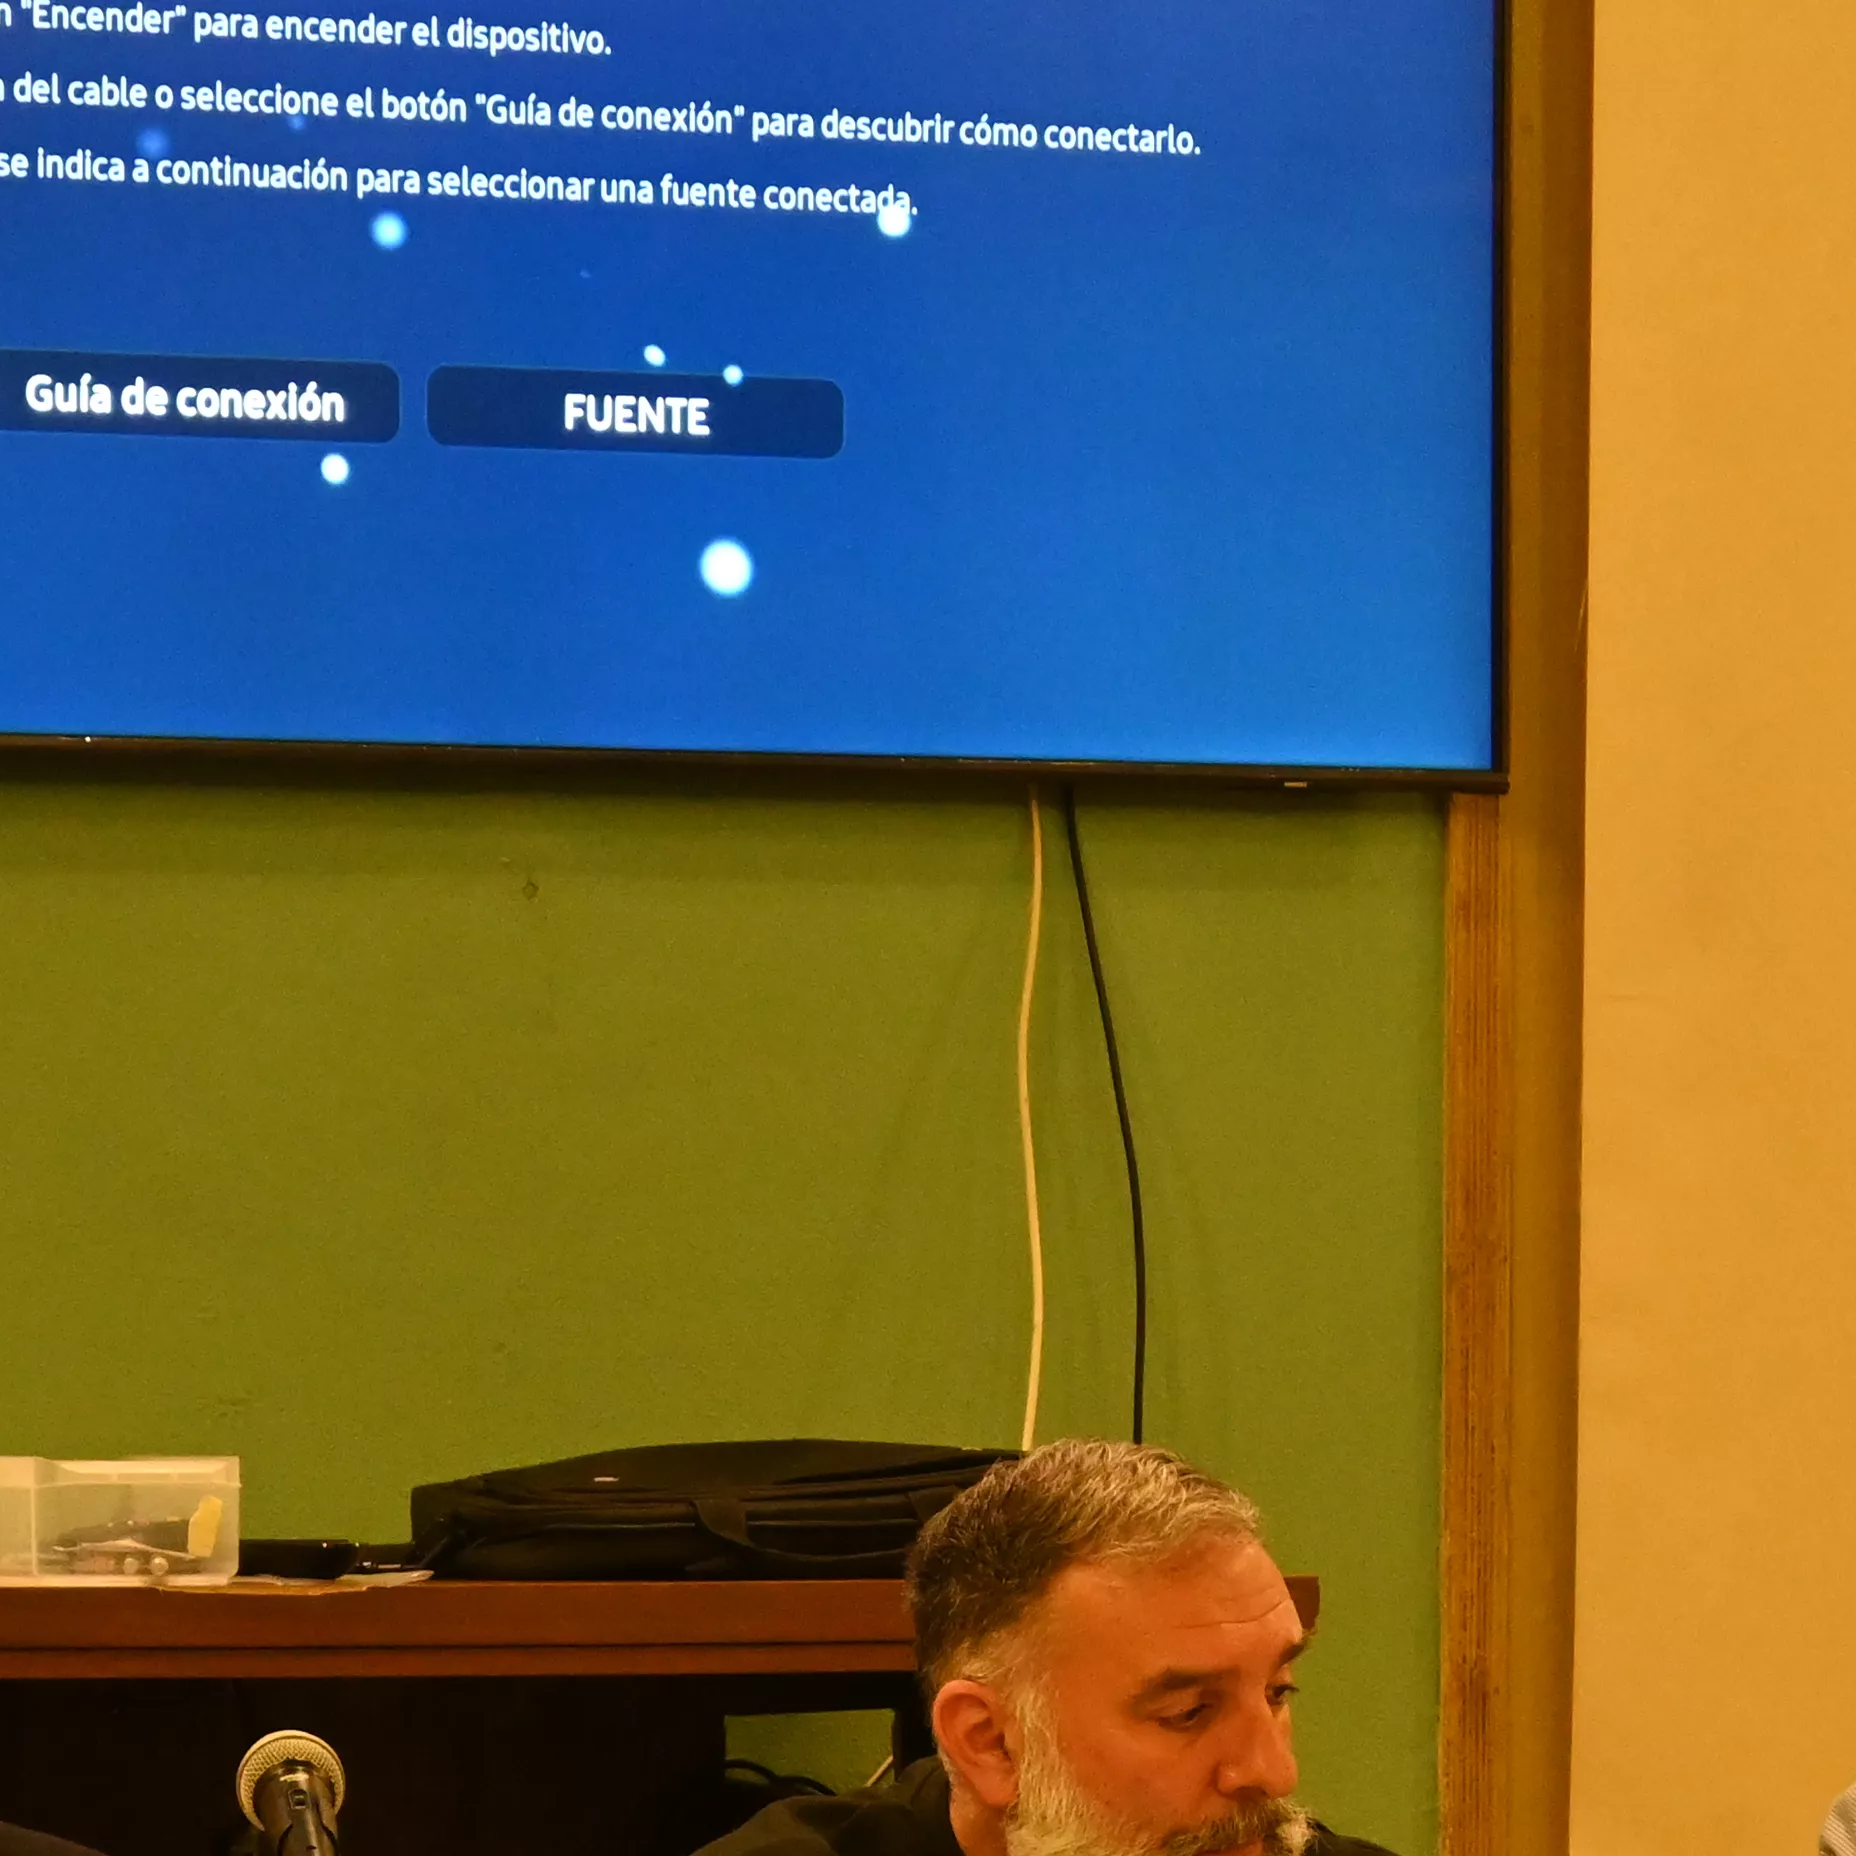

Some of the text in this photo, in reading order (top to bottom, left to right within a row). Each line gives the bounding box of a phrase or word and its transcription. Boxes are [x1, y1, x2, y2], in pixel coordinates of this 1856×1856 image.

[21, 0, 186, 34] "Encender"
[194, 11, 258, 43] para
[266, 13, 407, 44] encender
[412, 16, 440, 47] el
[447, 17, 611, 56] dispositivo.
[14, 71, 61, 104] del
[68, 75, 147, 108] cable
[155, 85, 173, 109] o
[181, 80, 338, 116] seleccione
[346, 87, 374, 118] el
[382, 88, 466, 122] botón
[476, 93, 551, 126] "Guía
[559, 96, 594, 127] de
[601, 101, 744, 133] conexión"
[753, 112, 814, 142] para
[821, 108, 955, 143] descubrir
[960, 114, 1037, 147] cómo
[1044, 124, 1200, 154] conectarlo.
[38, 147, 125, 181] indica
[132, 159, 149, 182] a
[157, 155, 347, 191] continuación
[357, 168, 420, 199] para
[428, 166, 595, 201] seleccionar
[601, 179, 653, 204] una
[660, 173, 756, 208] fuente
[764, 184, 917, 216] conectada.
[26, 373, 345, 422] Guía de conexión
[565, 394, 710, 435] FUENTE
